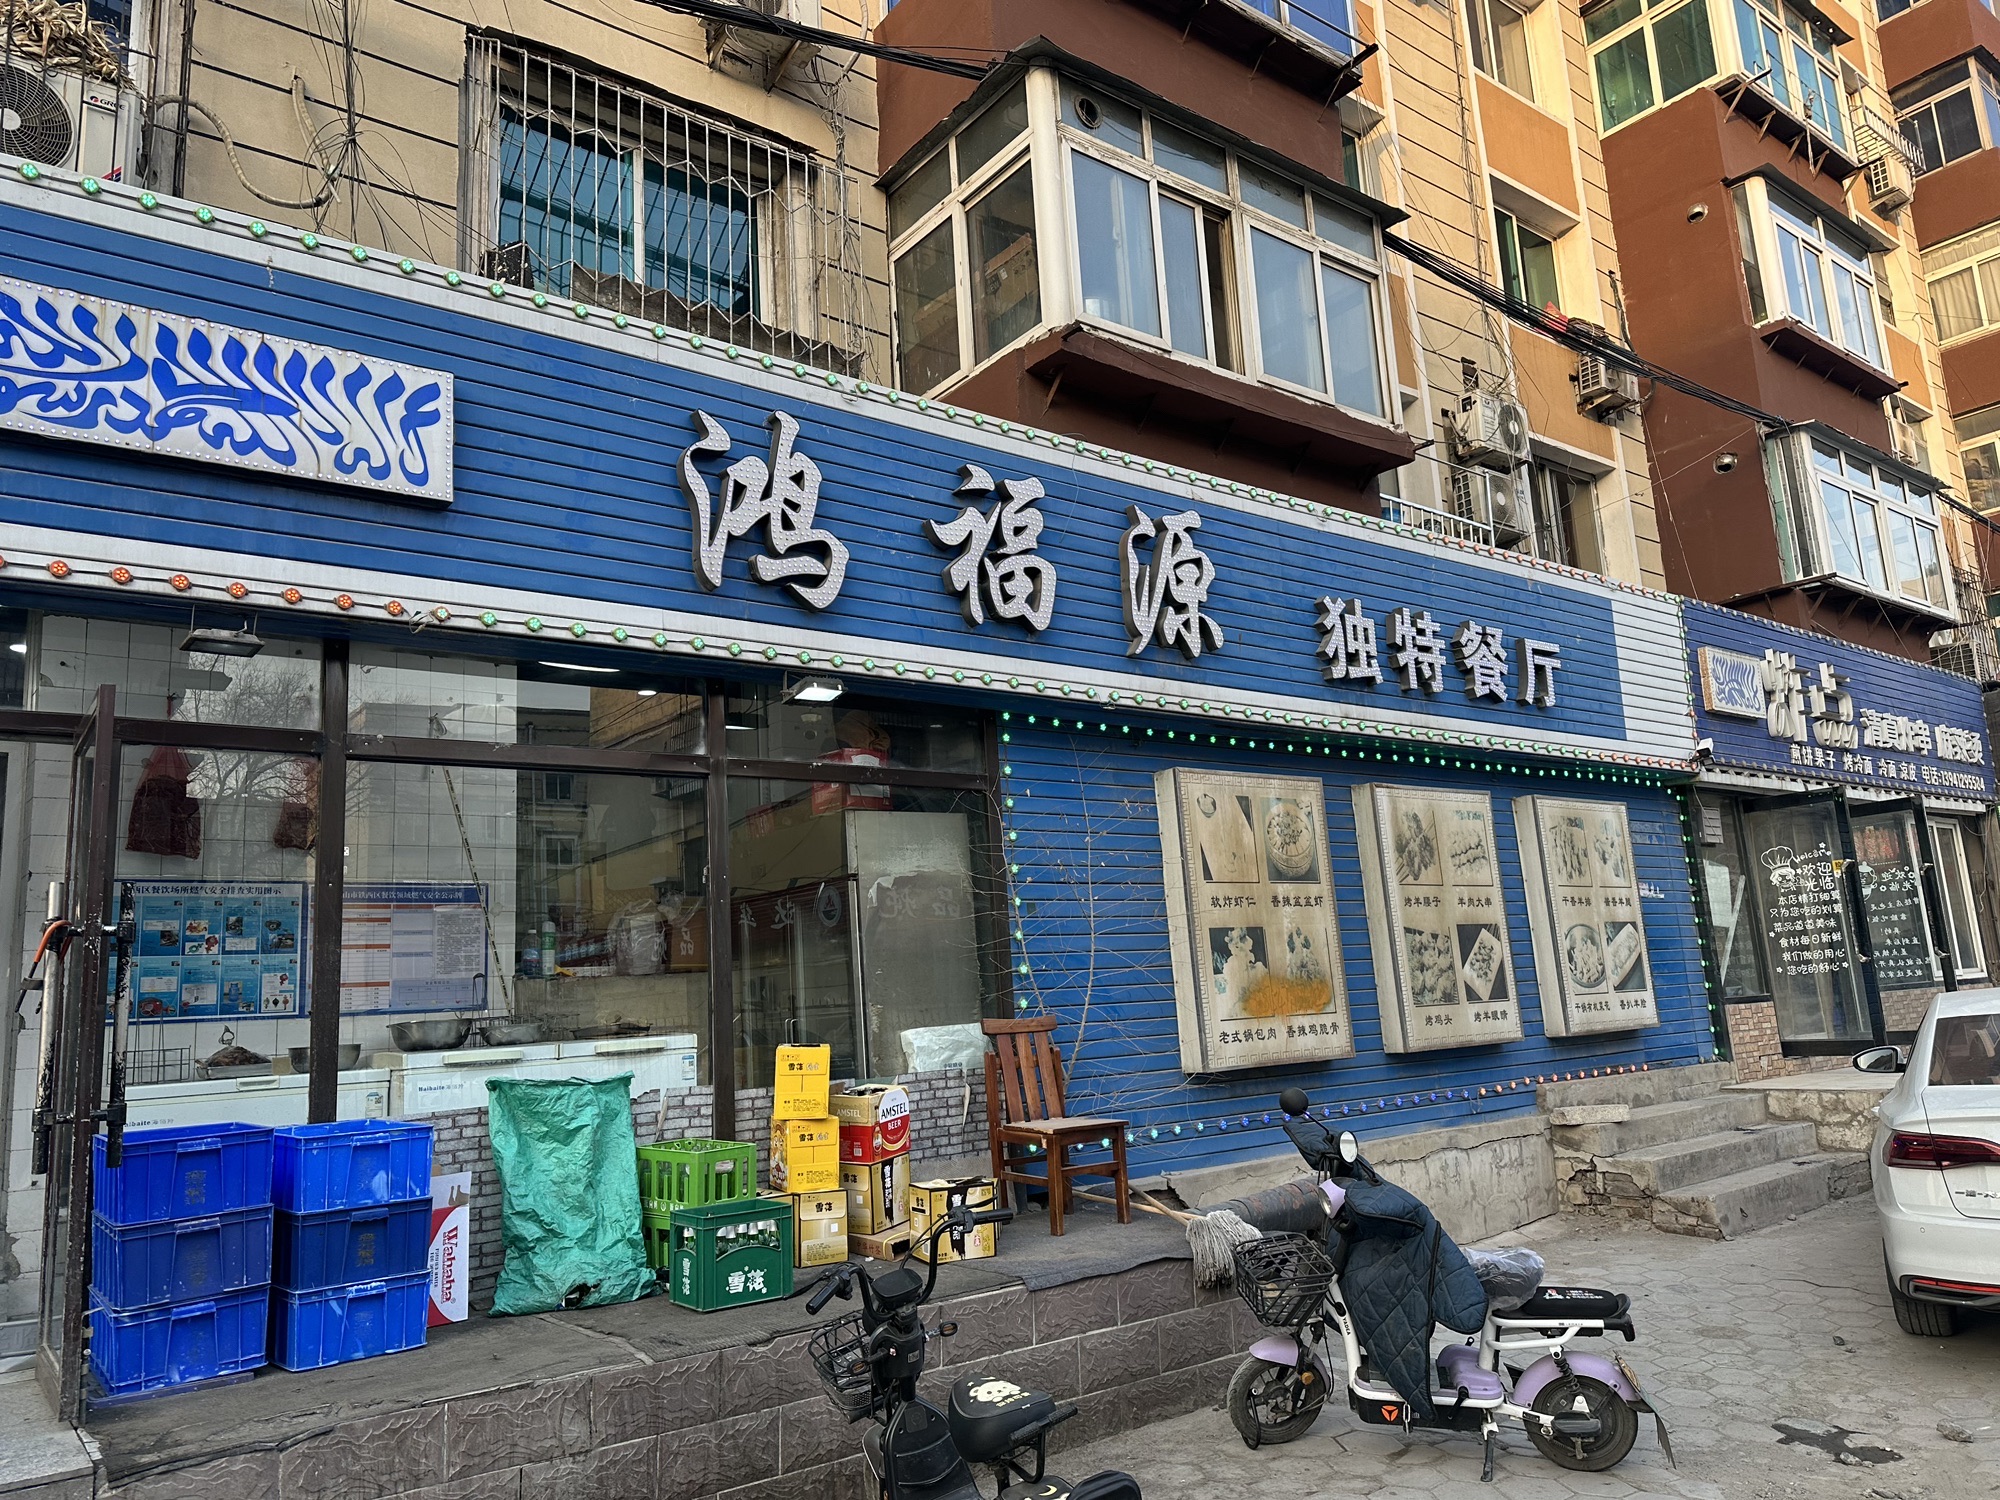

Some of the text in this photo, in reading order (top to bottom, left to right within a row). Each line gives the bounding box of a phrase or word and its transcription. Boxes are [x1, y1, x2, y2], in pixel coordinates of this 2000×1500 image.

[676, 408, 1563, 708] 鸿福源 独特餐厅
[1859, 707, 1932, 757] 清真炸串
[1934, 723, 1985, 766] 麻辣烫
[1789, 743, 1836, 770] 煎饼果子
[1842, 752, 1874, 776] 烤冷面
[1878, 758, 1897, 780] 冷面
[1899, 761, 1918, 782] 凉皮
[1802, 861, 1832, 877] 欢迎
[1806, 875, 1835, 892] 光临
[1210, 895, 1324, 908] 软炸虾仁 香辣盆盆虾
[1457, 896, 1493, 908] 羊肉大串
[1777, 889, 1841, 906] 本店精打细算
[1769, 903, 1843, 918] 只为您吃的划算
[1773, 917, 1837, 933] 菜品道道美味
[1778, 931, 1843, 948] 食材每日新鲜
[1782, 948, 1845, 962] 我们做的用心
[1787, 962, 1840, 976] 您吃的舒心
[1425, 1010, 1509, 1026] 烤鸡头 烤羊眼睛
[1219, 1021, 1340, 1045] 老式锅包肉 香辣鸡脆骨
[788, 1062, 804, 1071] 雪花
[836, 1107, 862, 1118] AMSTEL
[881, 1102, 908, 1119] AMSTEL
[887, 1119, 902, 1131] BEER
[799, 1133, 814, 1142] 雪花
[842, 1173, 858, 1184] 雪花
[815, 1202, 834, 1213] 雪花
[441, 1225, 459, 1305] Wahaha
[682, 1257, 691, 1296] 雪花
[727, 1268, 766, 1294] 雪花
[1342, 1317, 1351, 1336] YADEA
